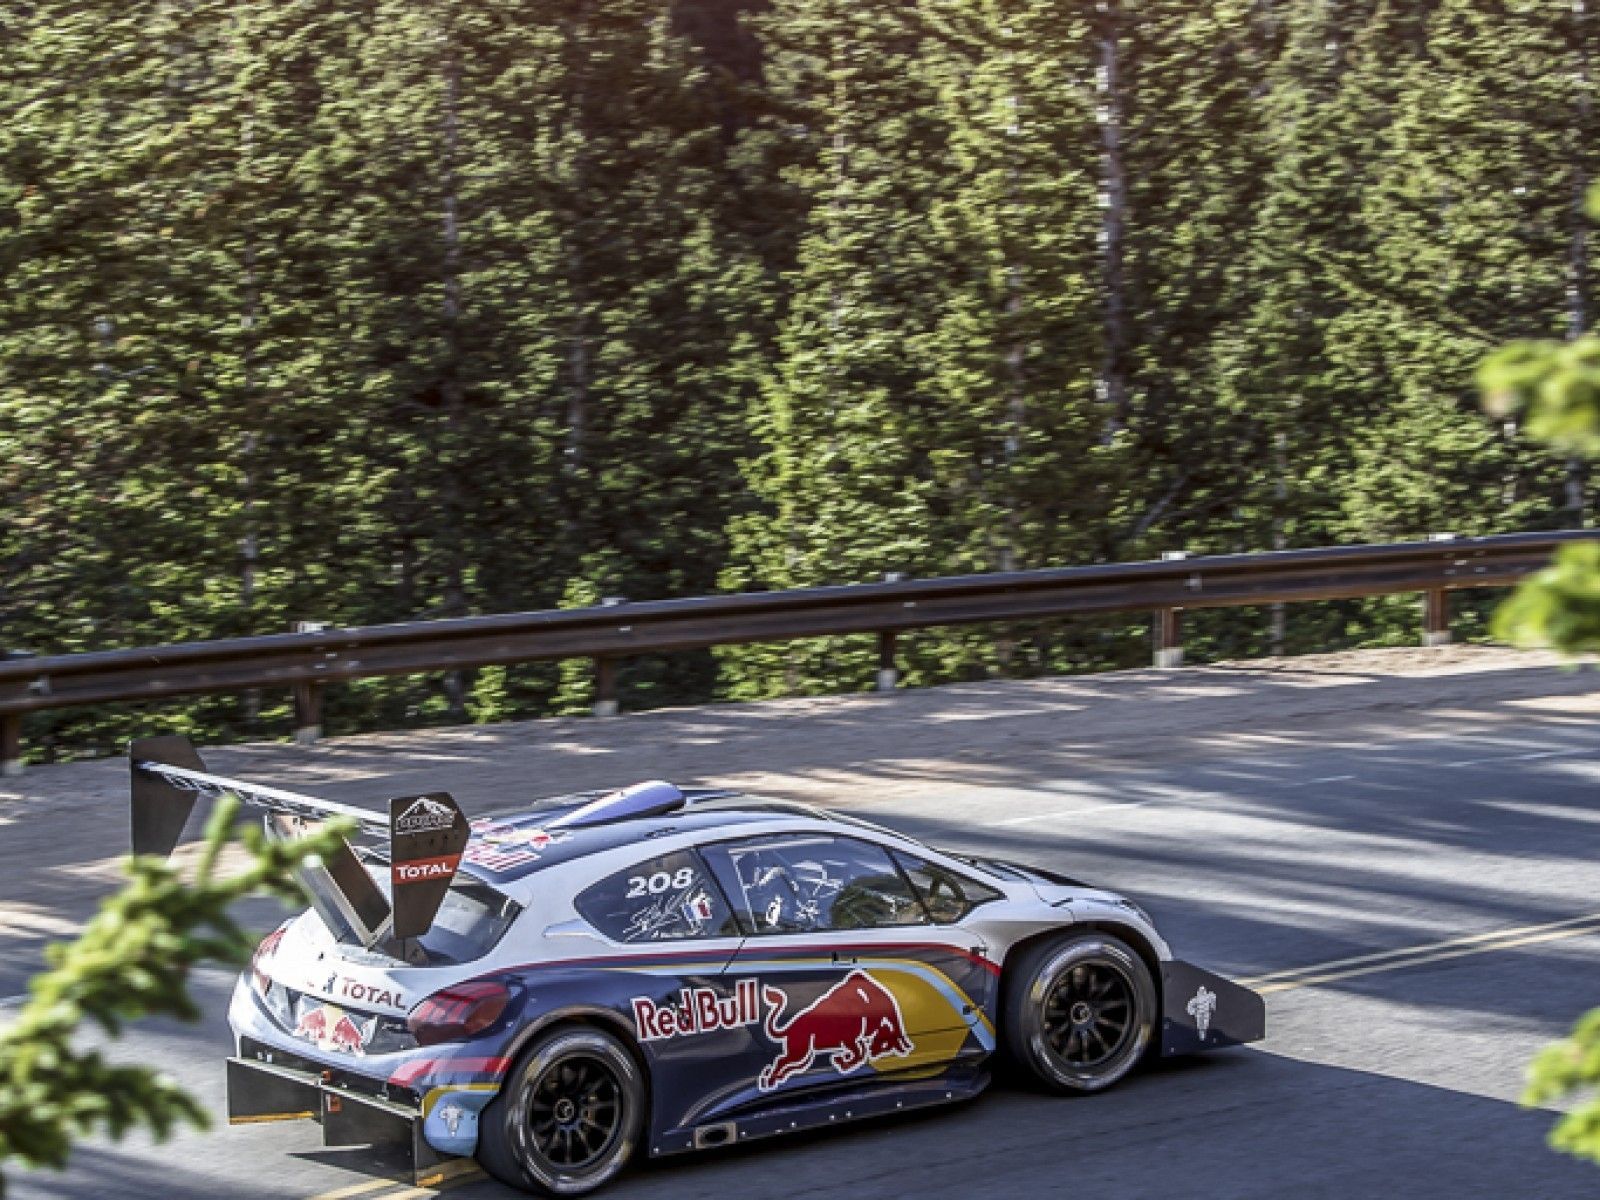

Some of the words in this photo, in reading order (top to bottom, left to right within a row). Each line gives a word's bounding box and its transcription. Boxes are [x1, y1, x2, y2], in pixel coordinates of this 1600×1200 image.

[396, 862, 453, 879] TOTAL
[625, 867, 694, 898] 208
[341, 977, 406, 1010] TOTAL
[631, 988, 696, 1042] Red
[693, 978, 760, 1031] Bull
